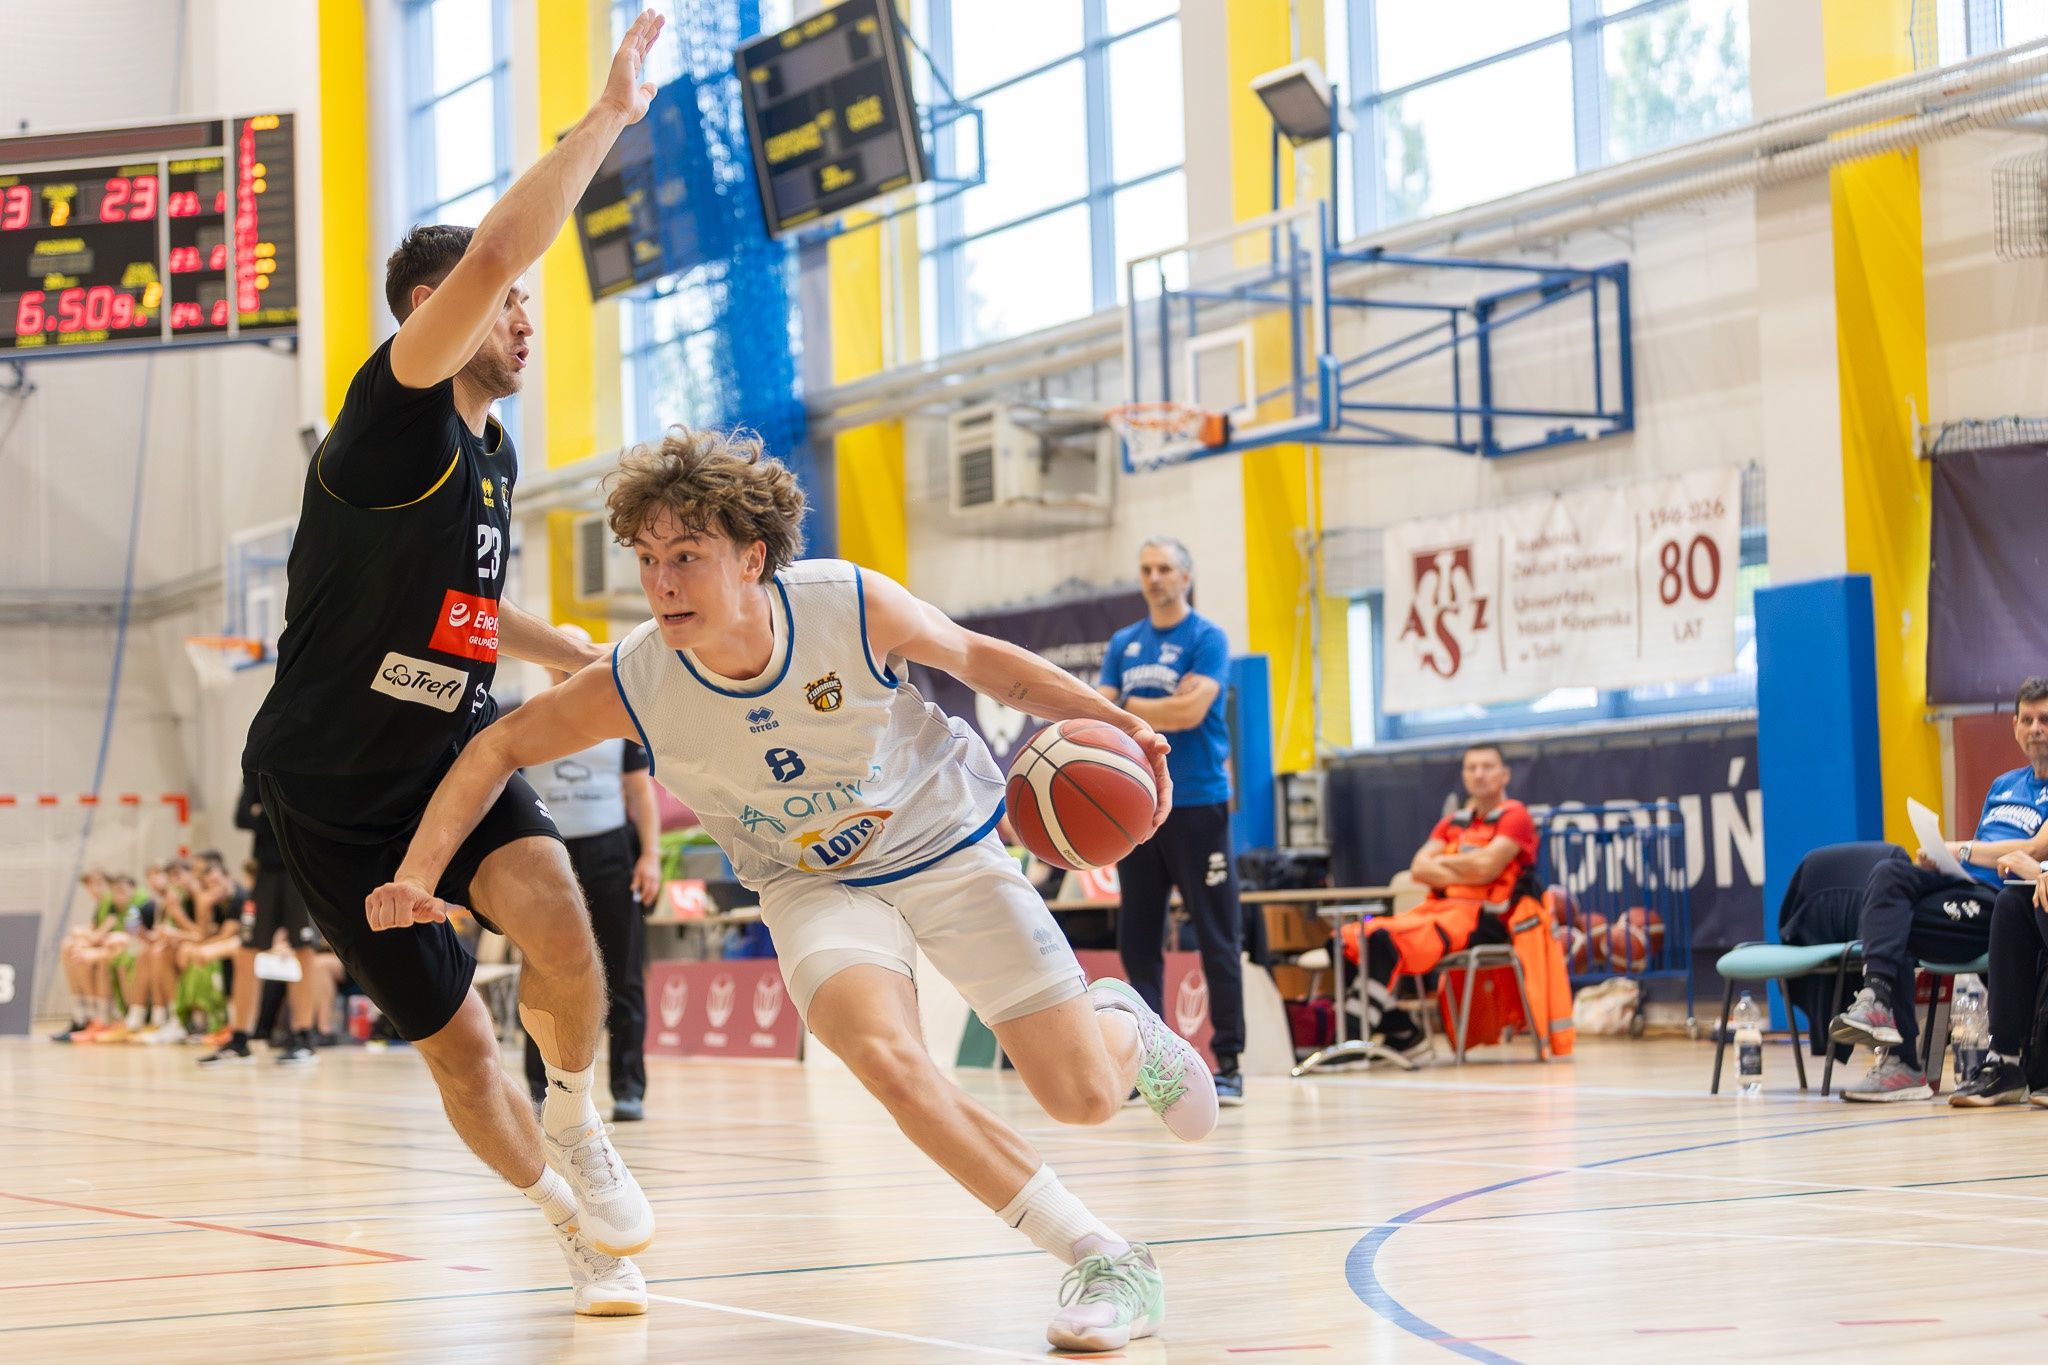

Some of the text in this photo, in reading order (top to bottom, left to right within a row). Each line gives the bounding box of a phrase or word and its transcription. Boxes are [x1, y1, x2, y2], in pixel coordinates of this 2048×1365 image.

[100, 175, 158, 223] 23
[477, 524, 502, 580] 23
[1660, 533, 1720, 605] 80
[1673, 617, 1704, 642] LAT
[410, 669, 462, 700] Trefl
[764, 747, 807, 784] 8
[1527, 756, 1766, 894] ORUŃ
